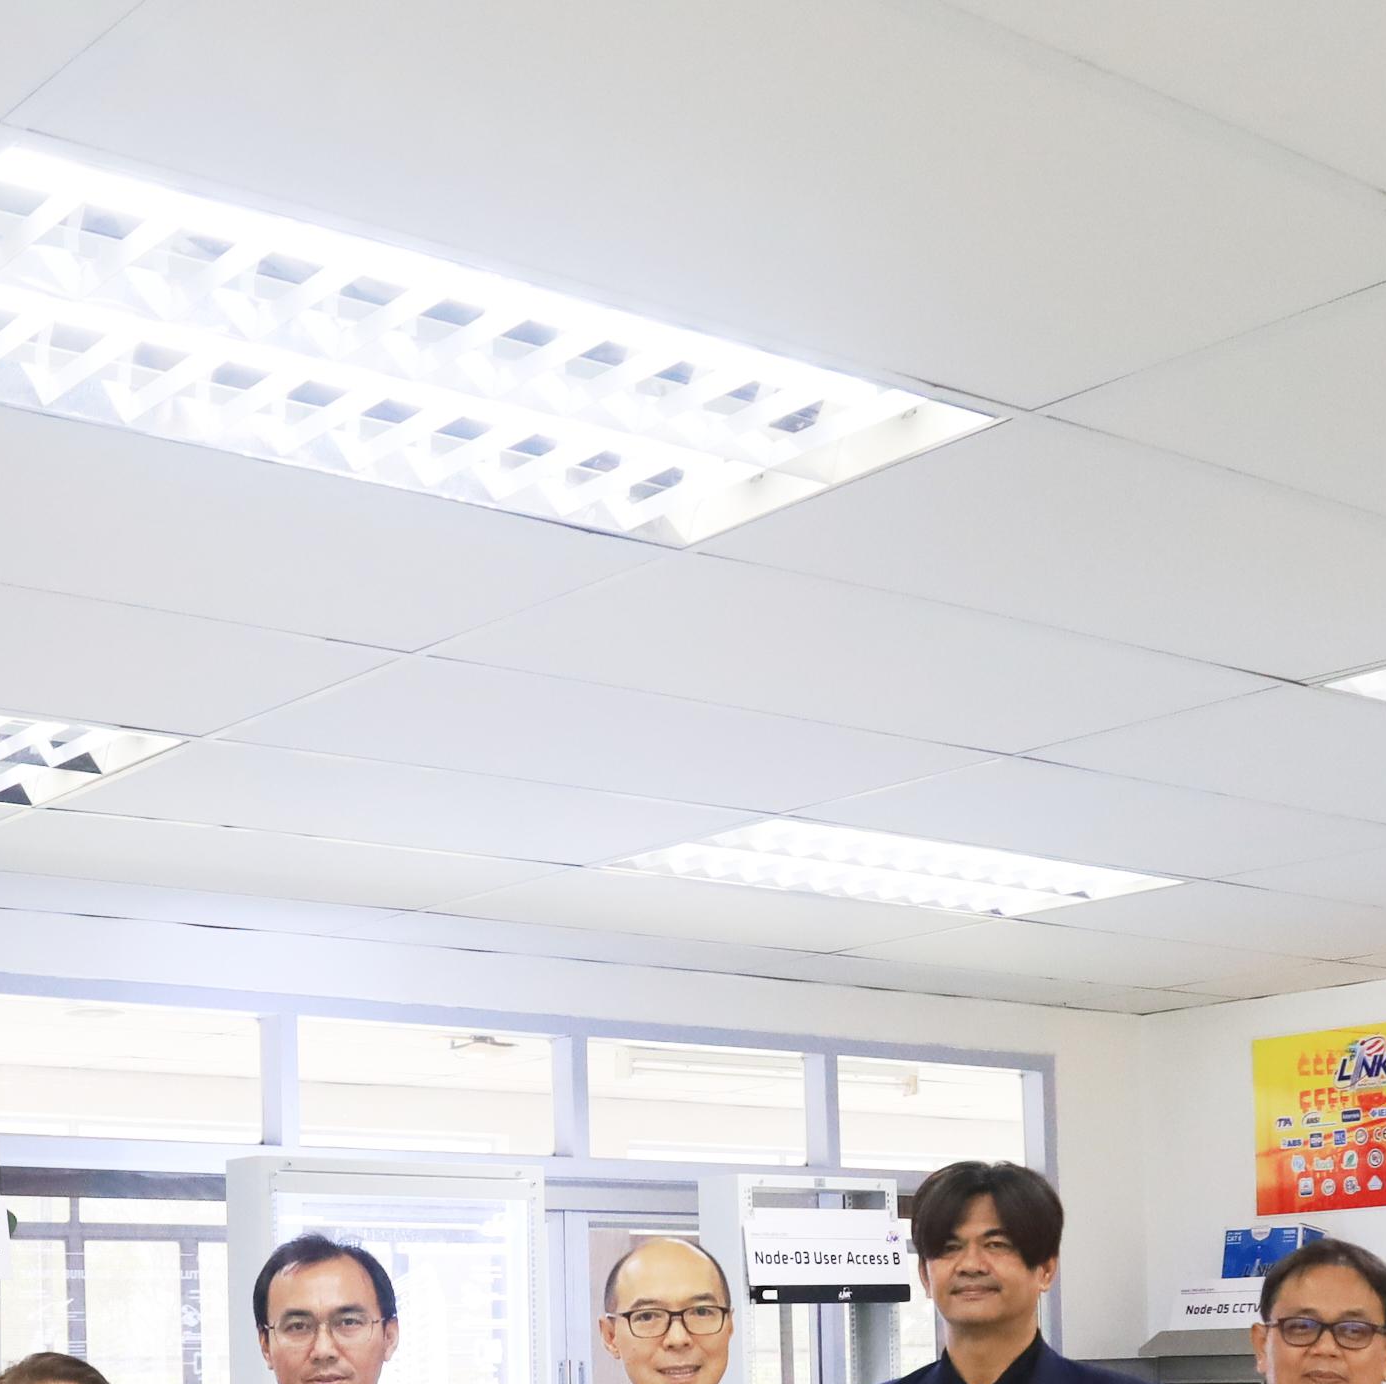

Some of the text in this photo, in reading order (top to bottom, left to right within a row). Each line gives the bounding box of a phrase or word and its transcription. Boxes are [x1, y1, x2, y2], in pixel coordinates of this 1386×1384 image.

[754, 1250, 901, 1266] Node-03 User Access B
[1185, 1302, 1261, 1316] Node-05 CCTV
